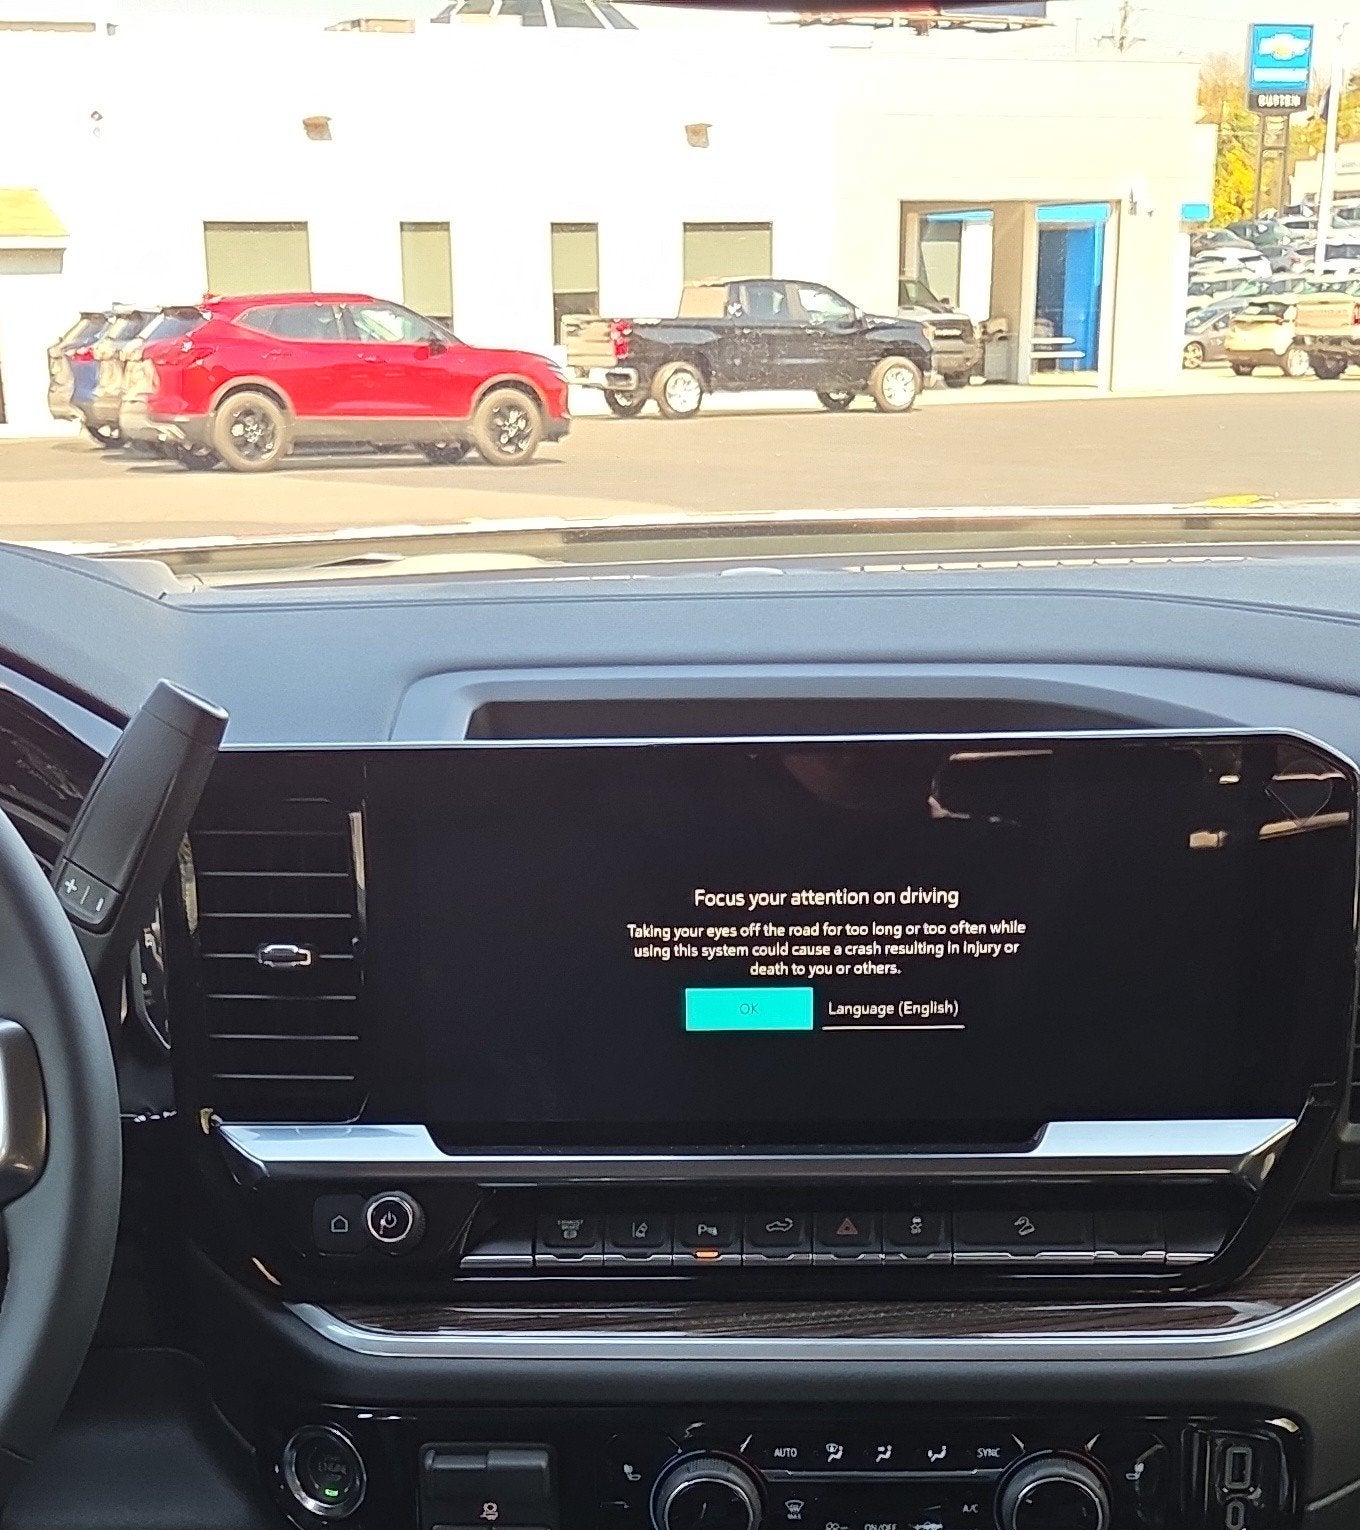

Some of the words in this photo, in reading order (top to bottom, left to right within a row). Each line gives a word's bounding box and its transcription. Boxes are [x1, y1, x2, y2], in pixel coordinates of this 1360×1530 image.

[694, 889, 745, 907] Focus
[749, 892, 787, 911] your
[790, 887, 869, 905] attention
[873, 891, 896, 905] on
[900, 886, 959, 908] driving
[627, 923, 671, 942] Taking
[673, 926, 704, 941] your
[706, 926, 737, 941] eyes
[739, 922, 761, 937] off
[763, 923, 785, 936] the
[788, 922, 819, 936] road
[822, 921, 843, 936] for
[845, 923, 868, 936] too
[872, 921, 902, 939] long
[905, 925, 921, 935] or
[923, 922, 946, 935] too
[949, 920, 987, 934] often
[990, 920, 1026, 934] while
[633, 944, 671, 961] using
[673, 943, 698, 957] this
[701, 945, 749, 960] system
[751, 942, 789, 956] could
[791, 945, 831, 956] cause
[833, 945, 842, 956] a
[845, 941, 882, 956] crash
[885, 940, 944, 958] resulting
[947, 941, 960, 954] in
[963, 940, 1002, 957] injury
[1004, 943, 1020, 954] or
[750, 961, 789, 976] death
[791, 963, 806, 976] to
[808, 964, 833, 978] you
[836, 964, 851, 975] or
[854, 961, 902, 975] others.
[739, 1003, 760, 1015] OK
[829, 1001, 894, 1018] Language
[898, 1000, 959, 1018] (English)
[774, 1447, 797, 1457] AUTO
